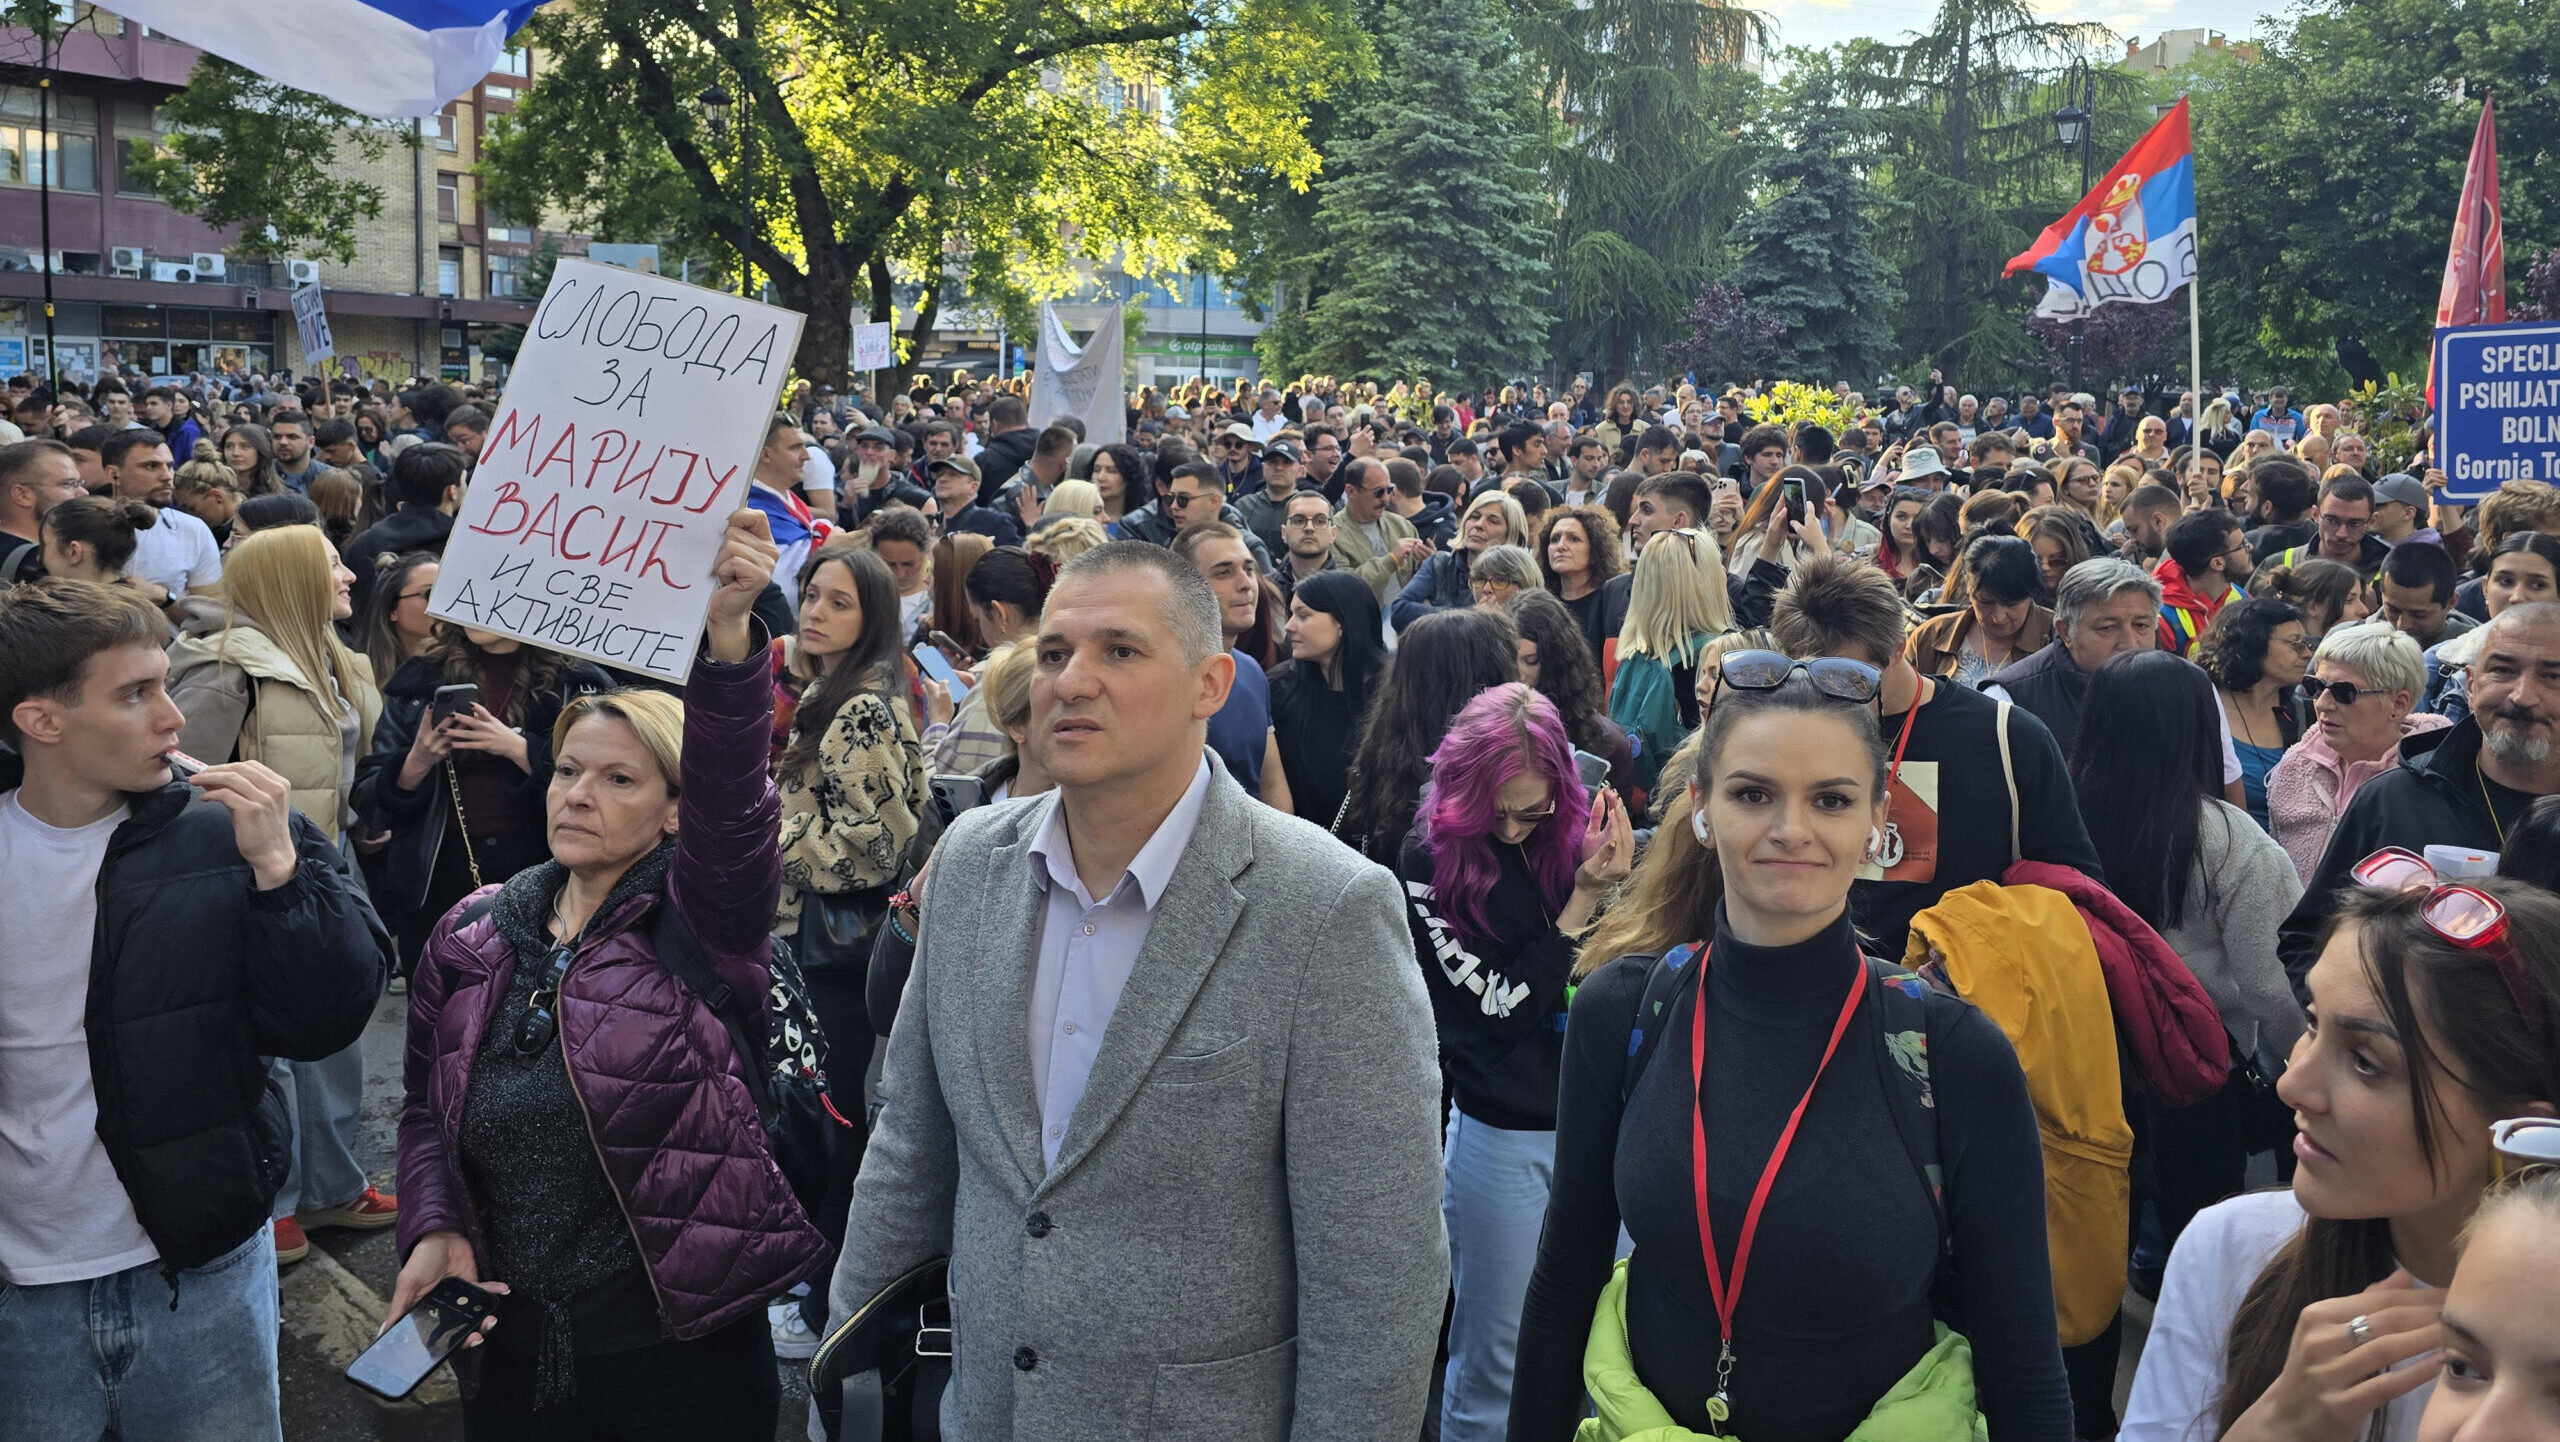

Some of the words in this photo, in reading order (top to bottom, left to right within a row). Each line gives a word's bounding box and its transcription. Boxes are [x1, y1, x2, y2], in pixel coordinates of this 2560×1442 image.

[538, 280, 778, 385] СЛОБОДА
[574, 358, 652, 417] ЗА
[2459, 379, 2560, 410] PSIHIJAT
[2502, 416, 2560, 444] BOLN
[480, 408, 738, 513] МАРИЈУ
[2455, 452, 2534, 483] Gornja
[469, 481, 691, 589] ВАСИЋ
[490, 554, 534, 588] И
[546, 569, 634, 611] СВЕ
[445, 579, 684, 672] АКТИВИСТЕ
